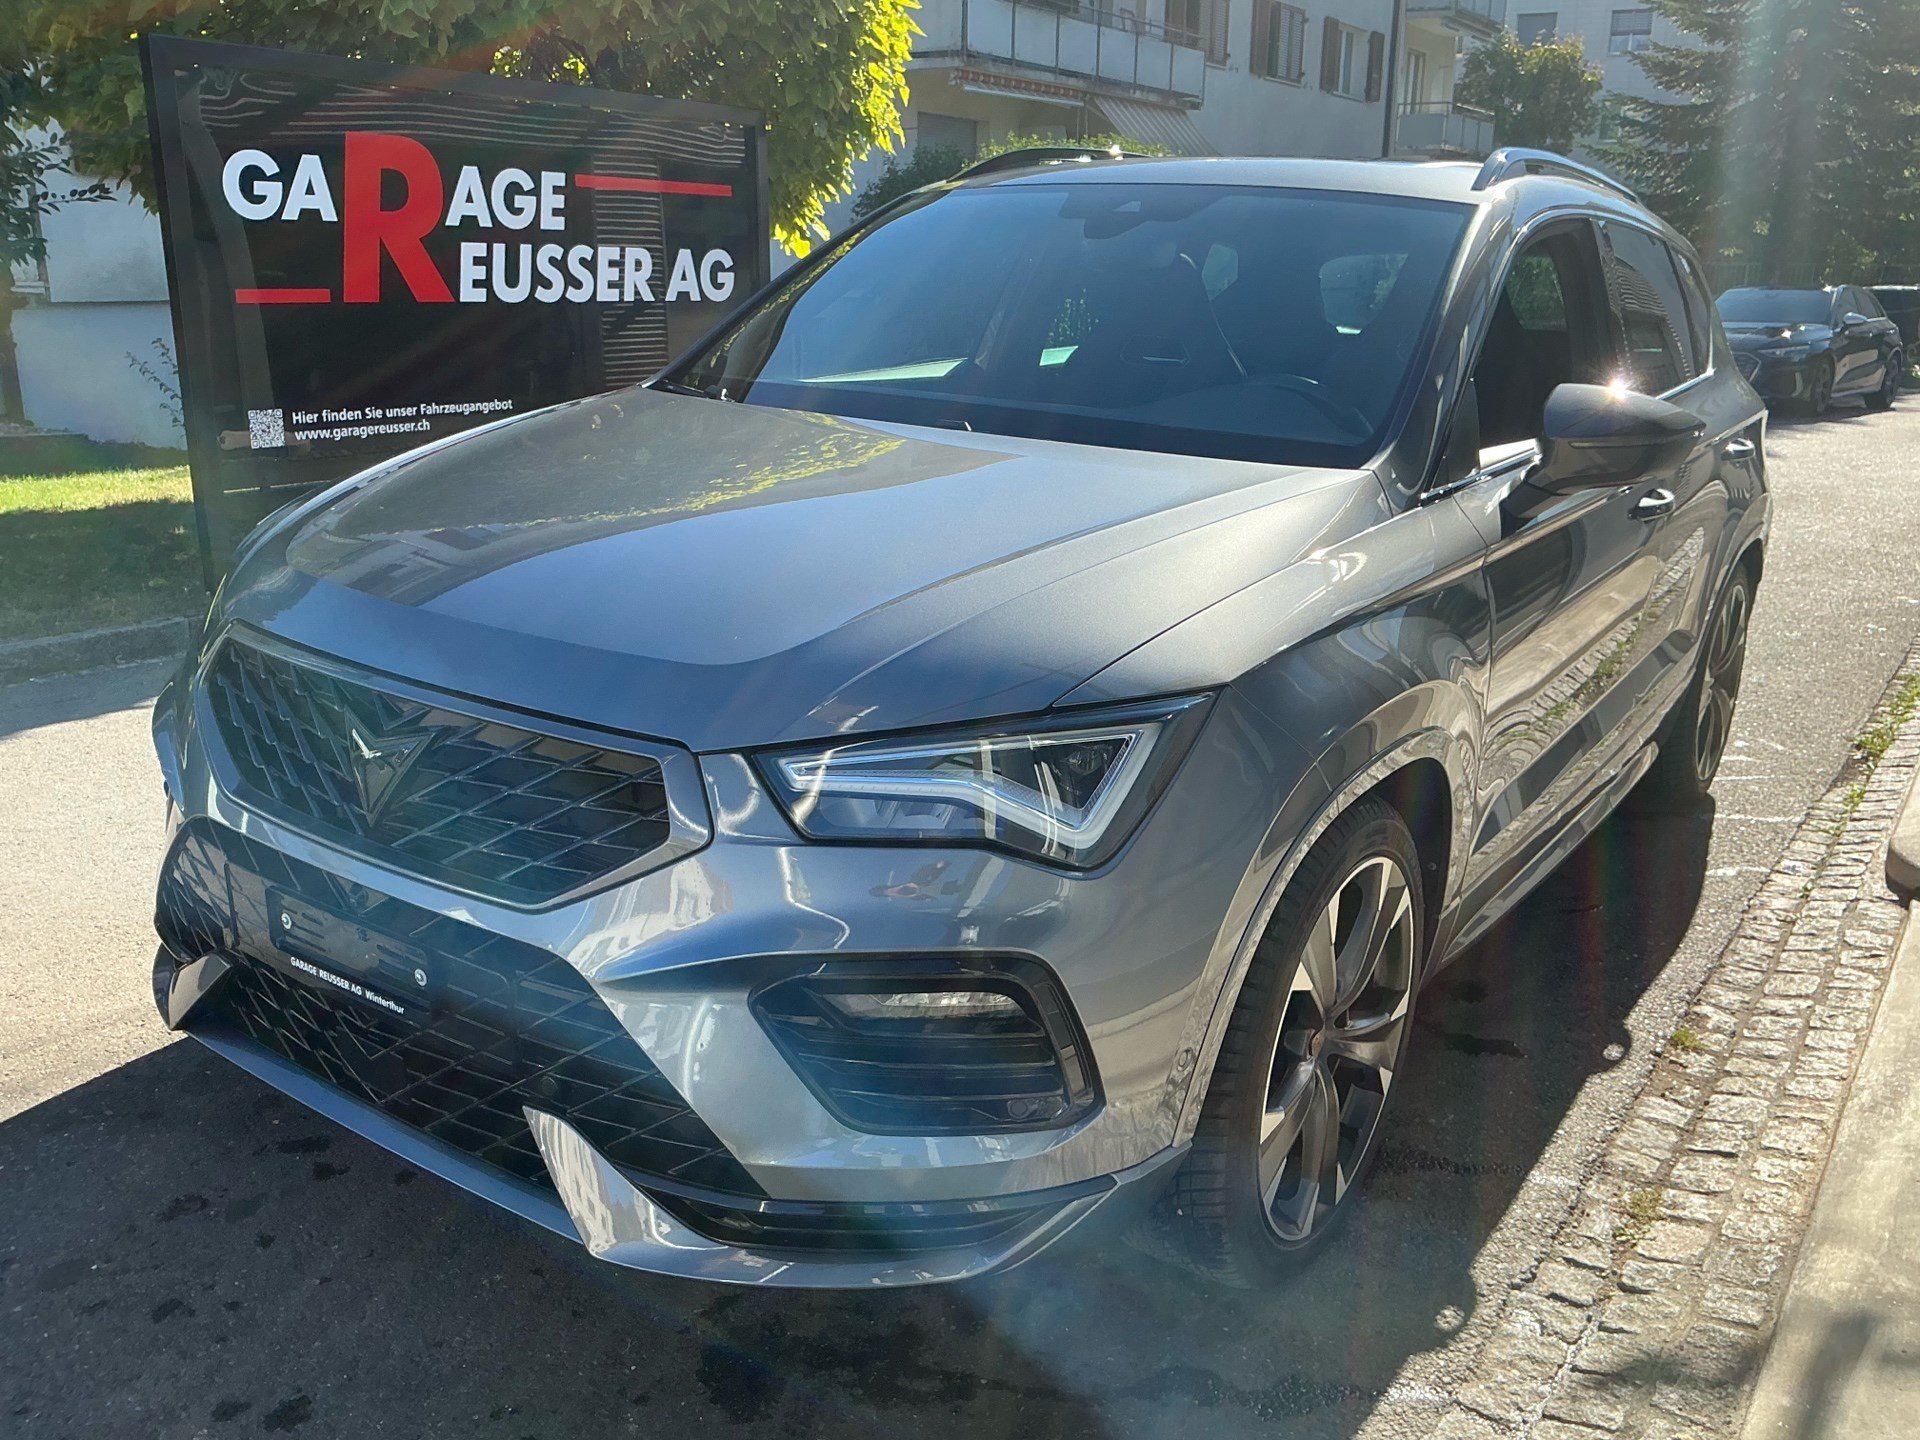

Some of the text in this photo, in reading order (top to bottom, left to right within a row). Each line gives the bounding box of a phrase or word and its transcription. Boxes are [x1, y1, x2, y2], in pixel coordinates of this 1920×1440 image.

[222, 131, 567, 303] GARAGE
[665, 248, 735, 303] AG
[292, 399, 514, 425] Hier finden Sie unser Fahrzeugangebot
[294, 419, 431, 441] www.garagereusser.ch
[290, 956, 405, 1015] GARAGE REUSSER AG Winterthur
